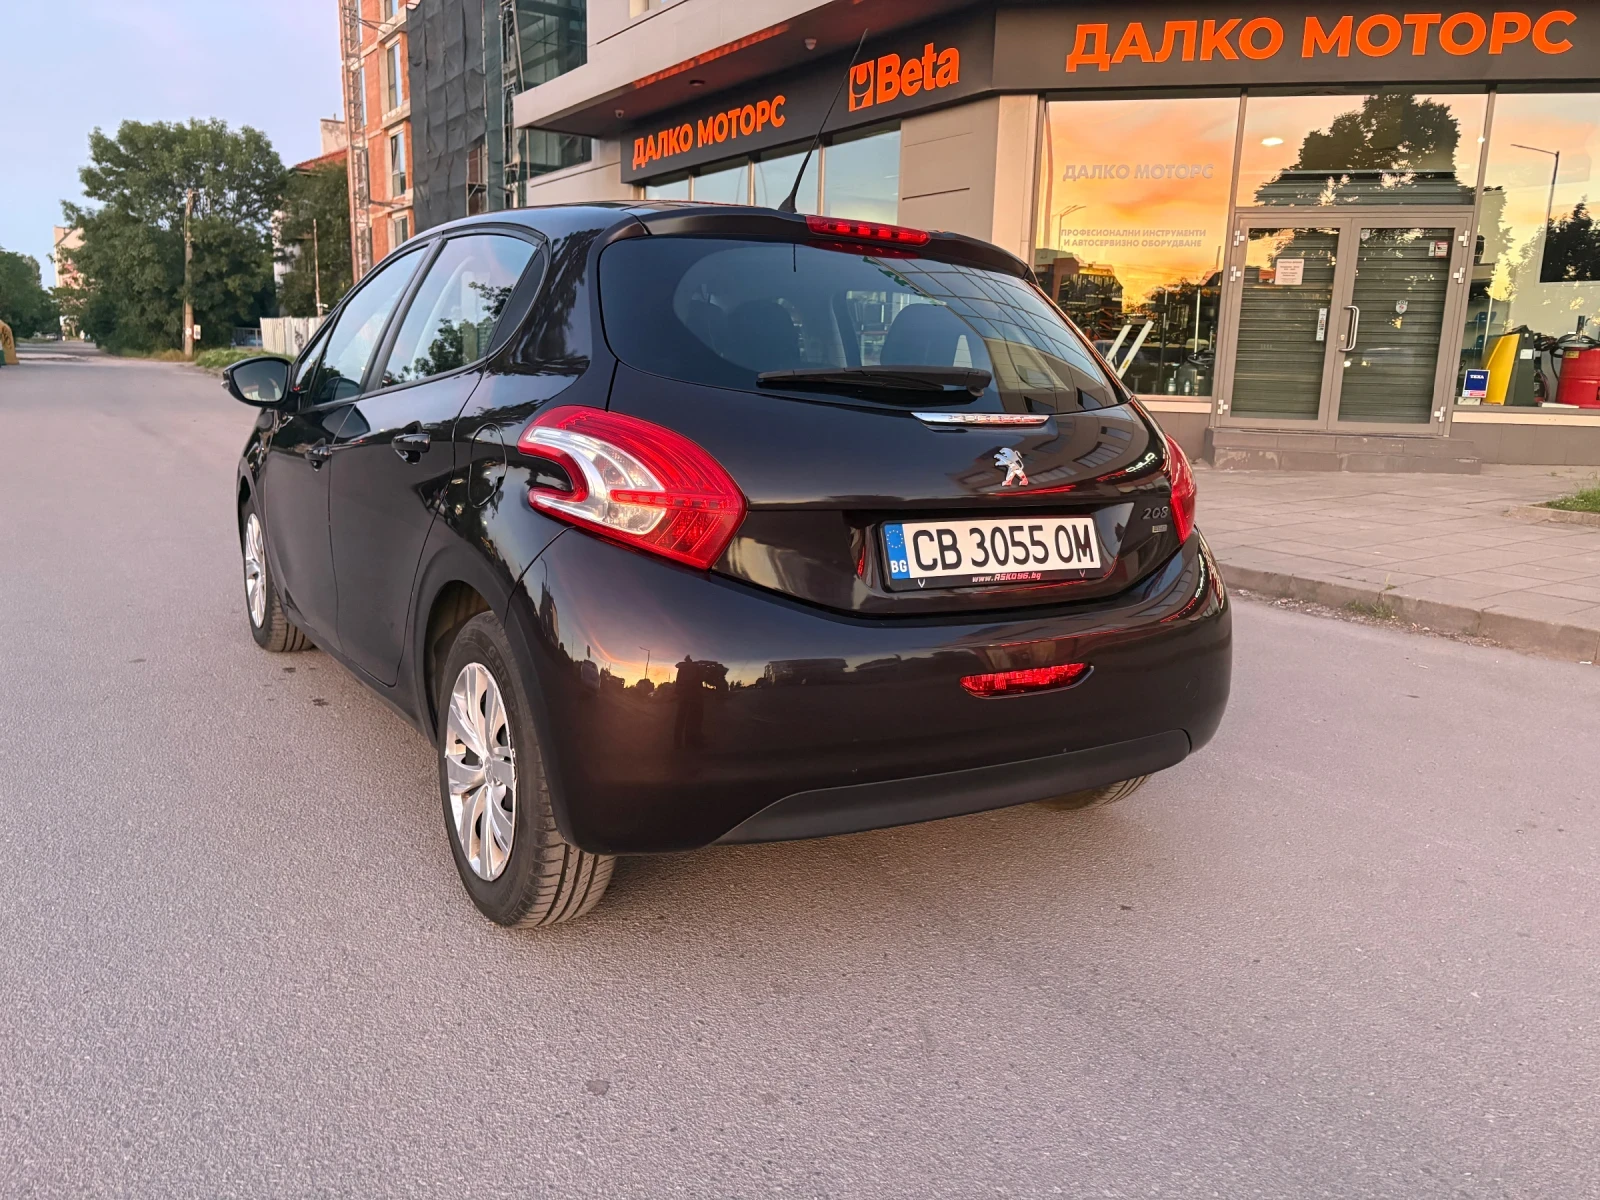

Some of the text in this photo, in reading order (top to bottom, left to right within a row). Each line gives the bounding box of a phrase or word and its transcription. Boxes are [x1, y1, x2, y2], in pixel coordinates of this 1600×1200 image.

[1065, 10, 1577, 73] ДАЛКО МОТОРС
[876, 42, 960, 104] Beta
[633, 95, 786, 170] ДАЛКО МОТОРС
[1063, 163, 1214, 181] ДАЛКО МОТОРС
[1061, 229, 1206, 237] ПРОФЕСИОНАЛНИ ИНСТРУМЕНТИ
[1072, 239, 1140, 247] АВТОСЕРВИЗНО
[1141, 239, 1202, 248] ОБОРУДВАНЕ
[1142, 506, 1169, 520] 208
[912, 523, 1095, 572] CB 3055 OM
[890, 560, 908, 573] BG
